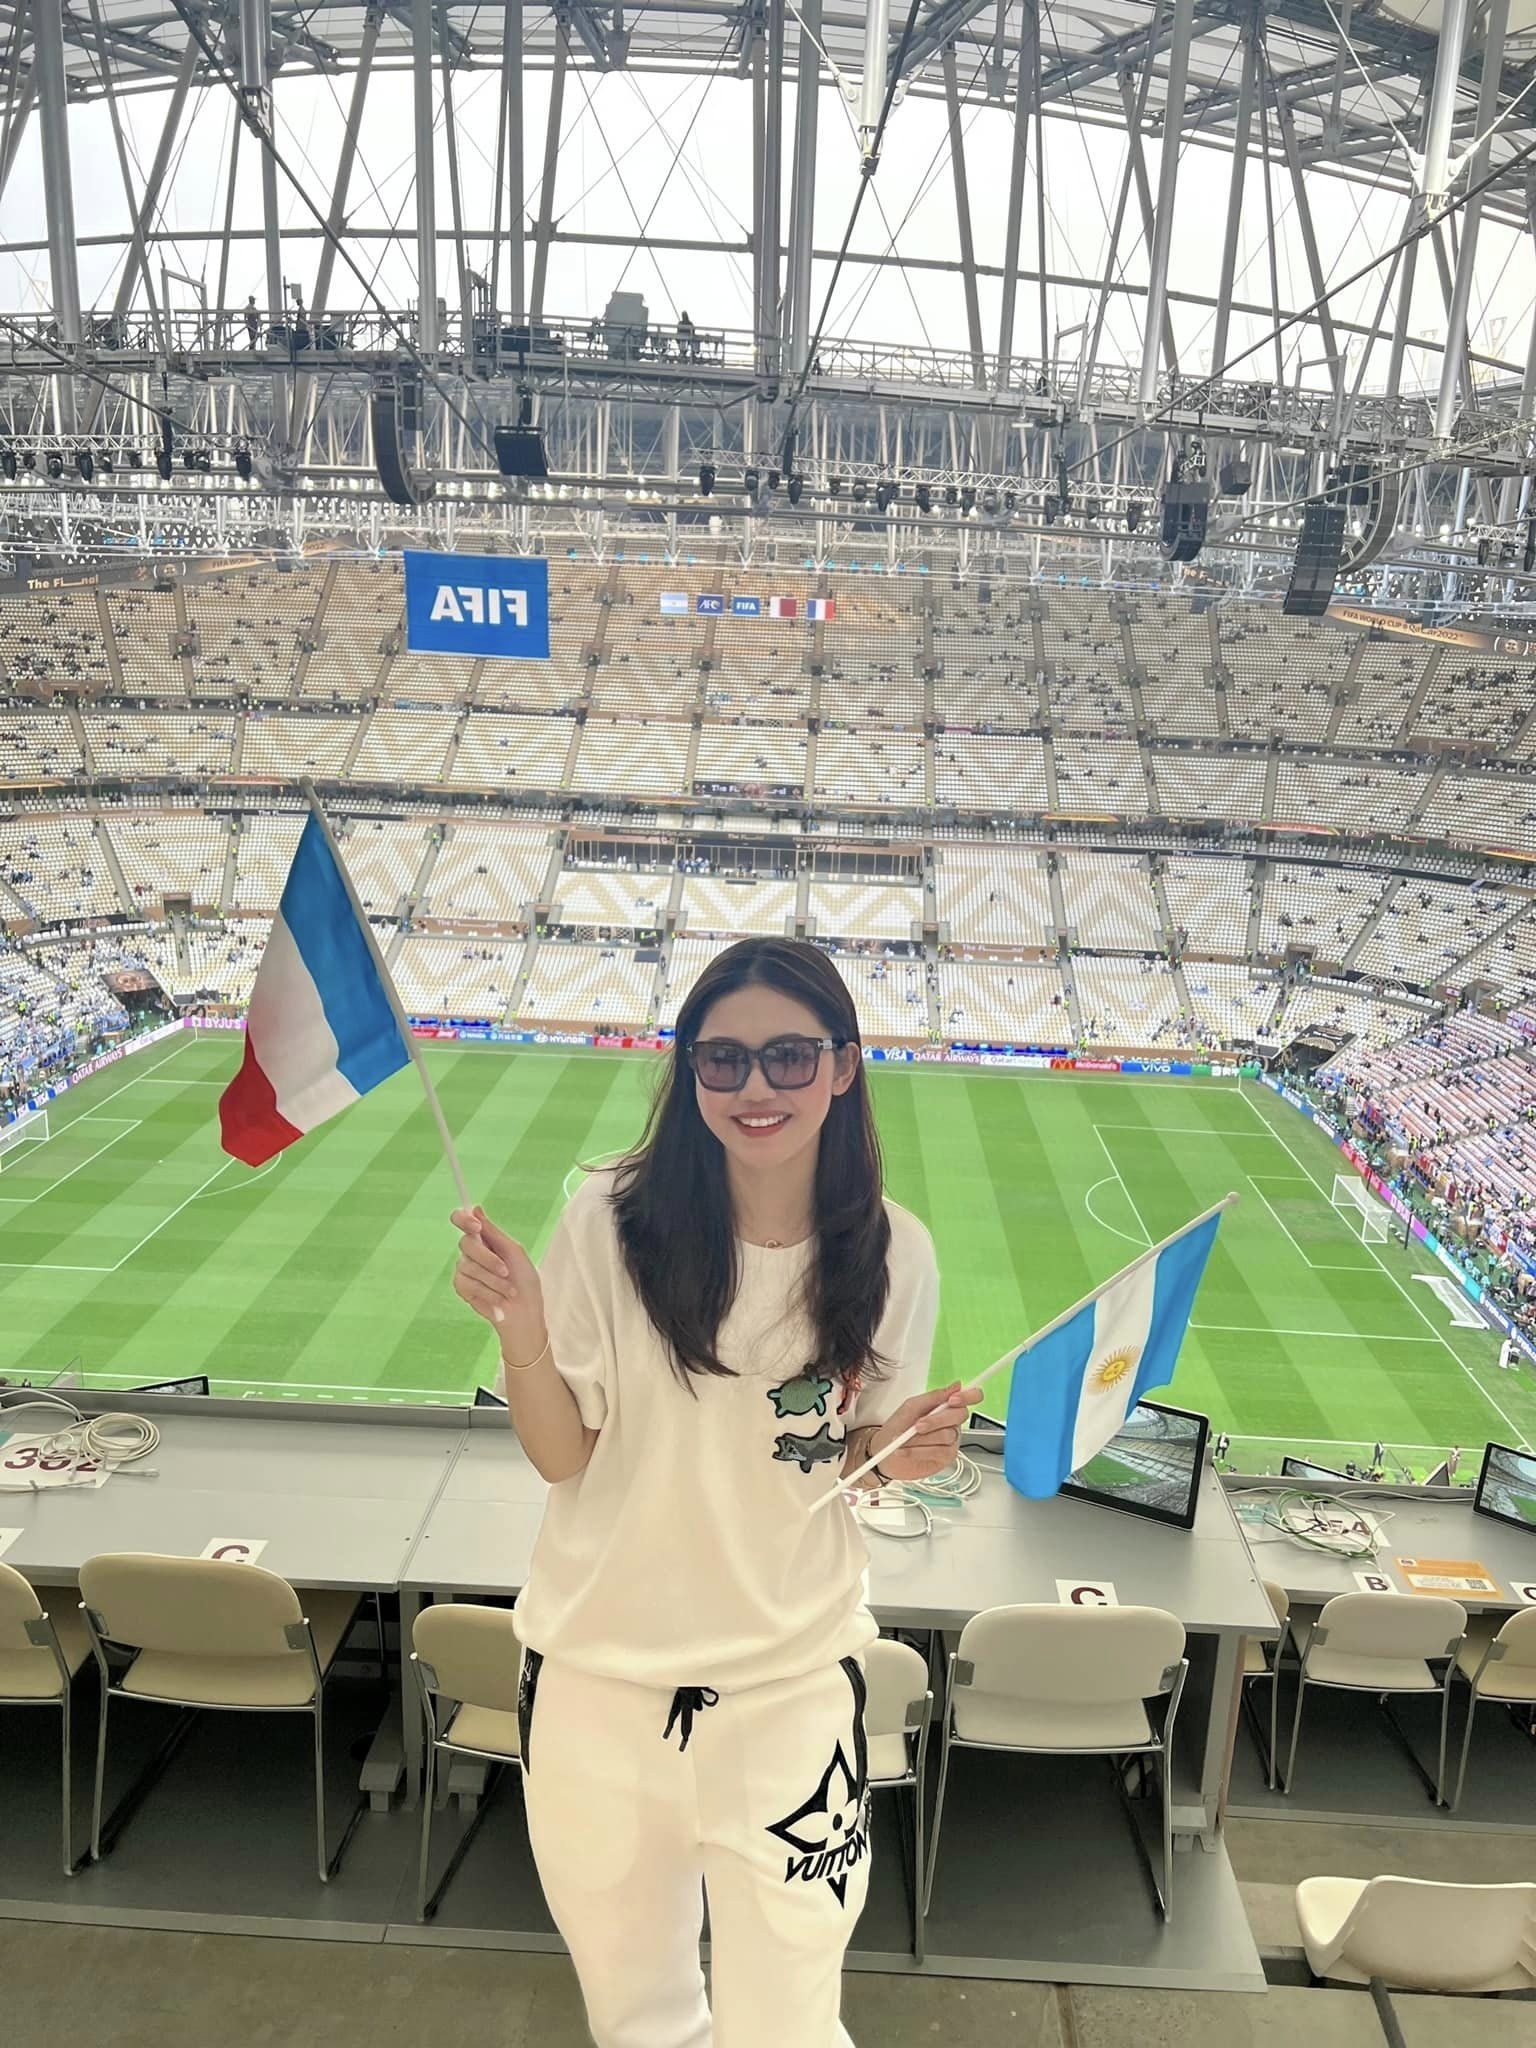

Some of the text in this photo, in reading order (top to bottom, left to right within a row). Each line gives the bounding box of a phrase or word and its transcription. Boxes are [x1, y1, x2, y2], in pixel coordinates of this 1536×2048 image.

[27, 579, 50, 590] The
[736, 601, 756, 610] FIFA
[1343, 610, 1359, 620] FIFA
[550, 1035, 587, 1044] HYUNDAI
[885, 1048, 907, 1061] VISA
[1140, 1063, 1171, 1073] vivo
[1364, 1576, 1389, 1592] B
[784, 1829, 868, 1884] VUITTON
